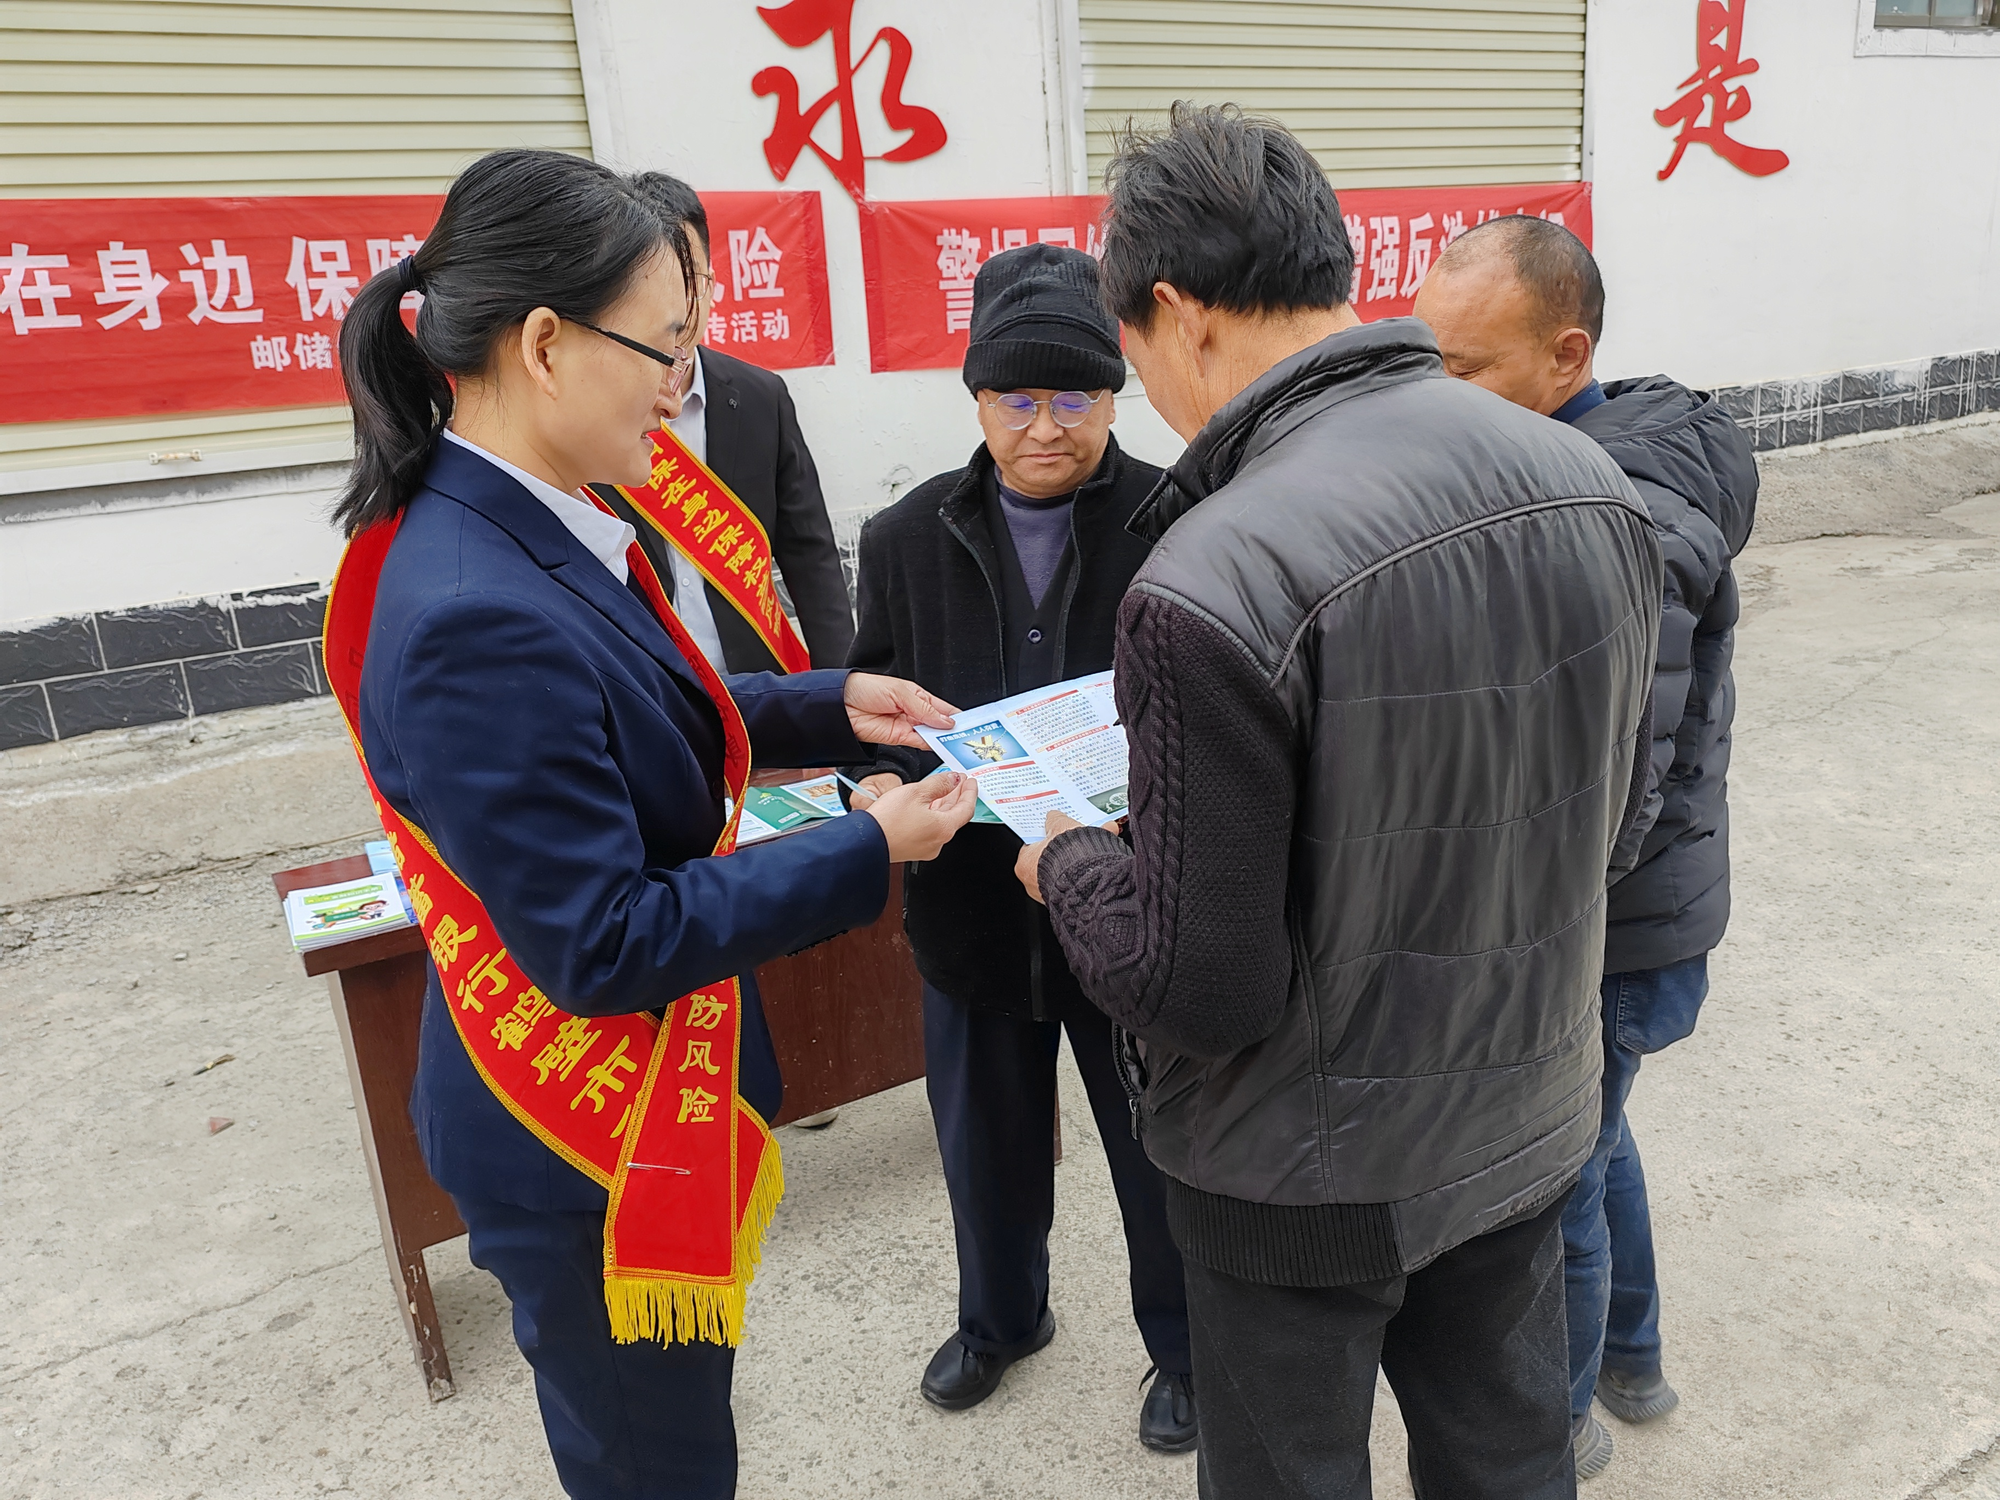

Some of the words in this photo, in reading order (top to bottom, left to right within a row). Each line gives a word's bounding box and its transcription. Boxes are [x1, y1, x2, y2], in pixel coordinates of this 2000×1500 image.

[1654, 0, 1790, 181] 是
[0, 239, 264, 335] 在身边
[713, 226, 785, 301] 险
[250, 331, 333, 372] 邮储
